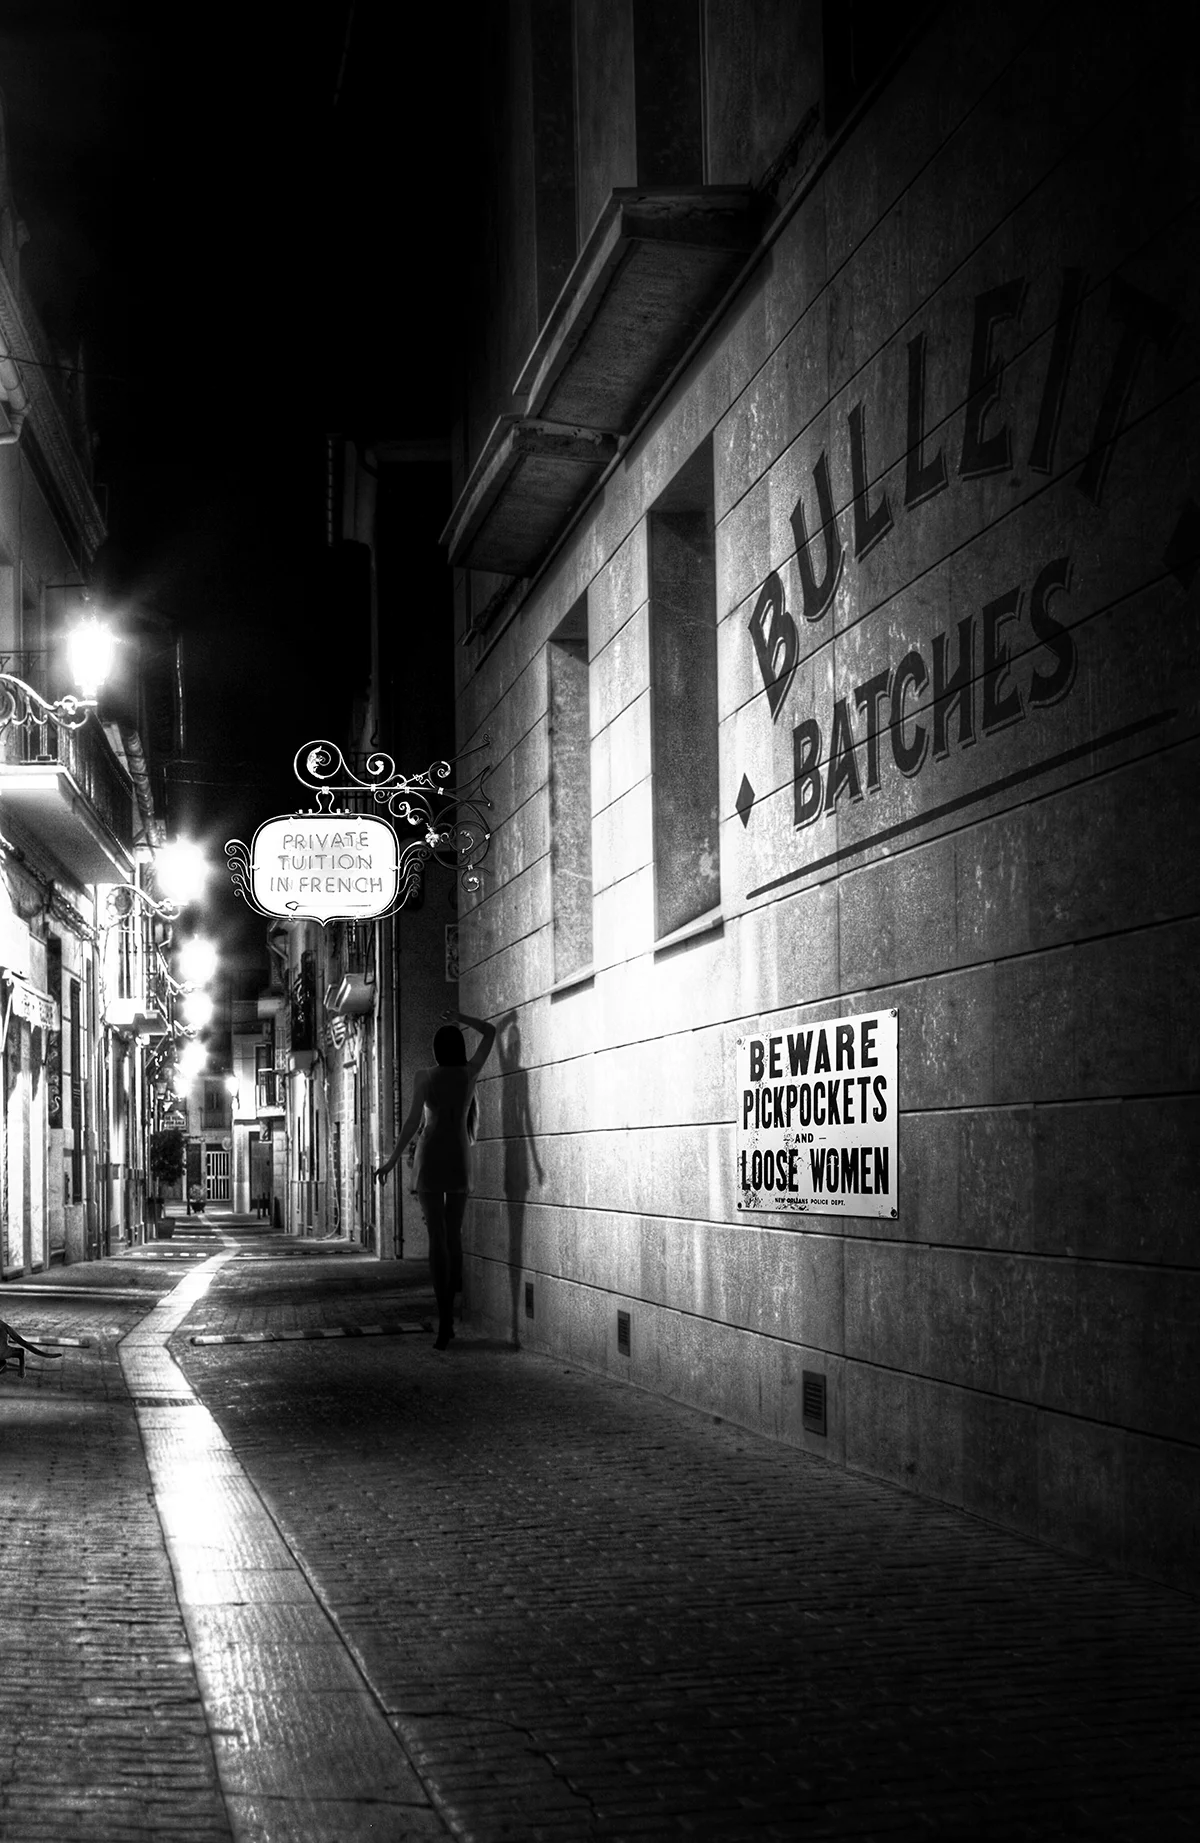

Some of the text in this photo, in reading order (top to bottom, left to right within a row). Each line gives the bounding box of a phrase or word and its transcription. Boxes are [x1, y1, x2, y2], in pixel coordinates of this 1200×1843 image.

[748, 266, 1186, 724] BULLEIT
[792, 556, 1079, 831] BATCHES
[277, 853, 373, 871] TUITION
[282, 831, 369, 850] PRIVATE
[270, 876, 383, 893] IN FRENCH
[750, 1019, 879, 1082] BEWARE
[743, 1075, 887, 1130] PICKPOCKETS
[794, 1132, 814, 1144] AND
[741, 1146, 889, 1195] LOOSE WOMEN
